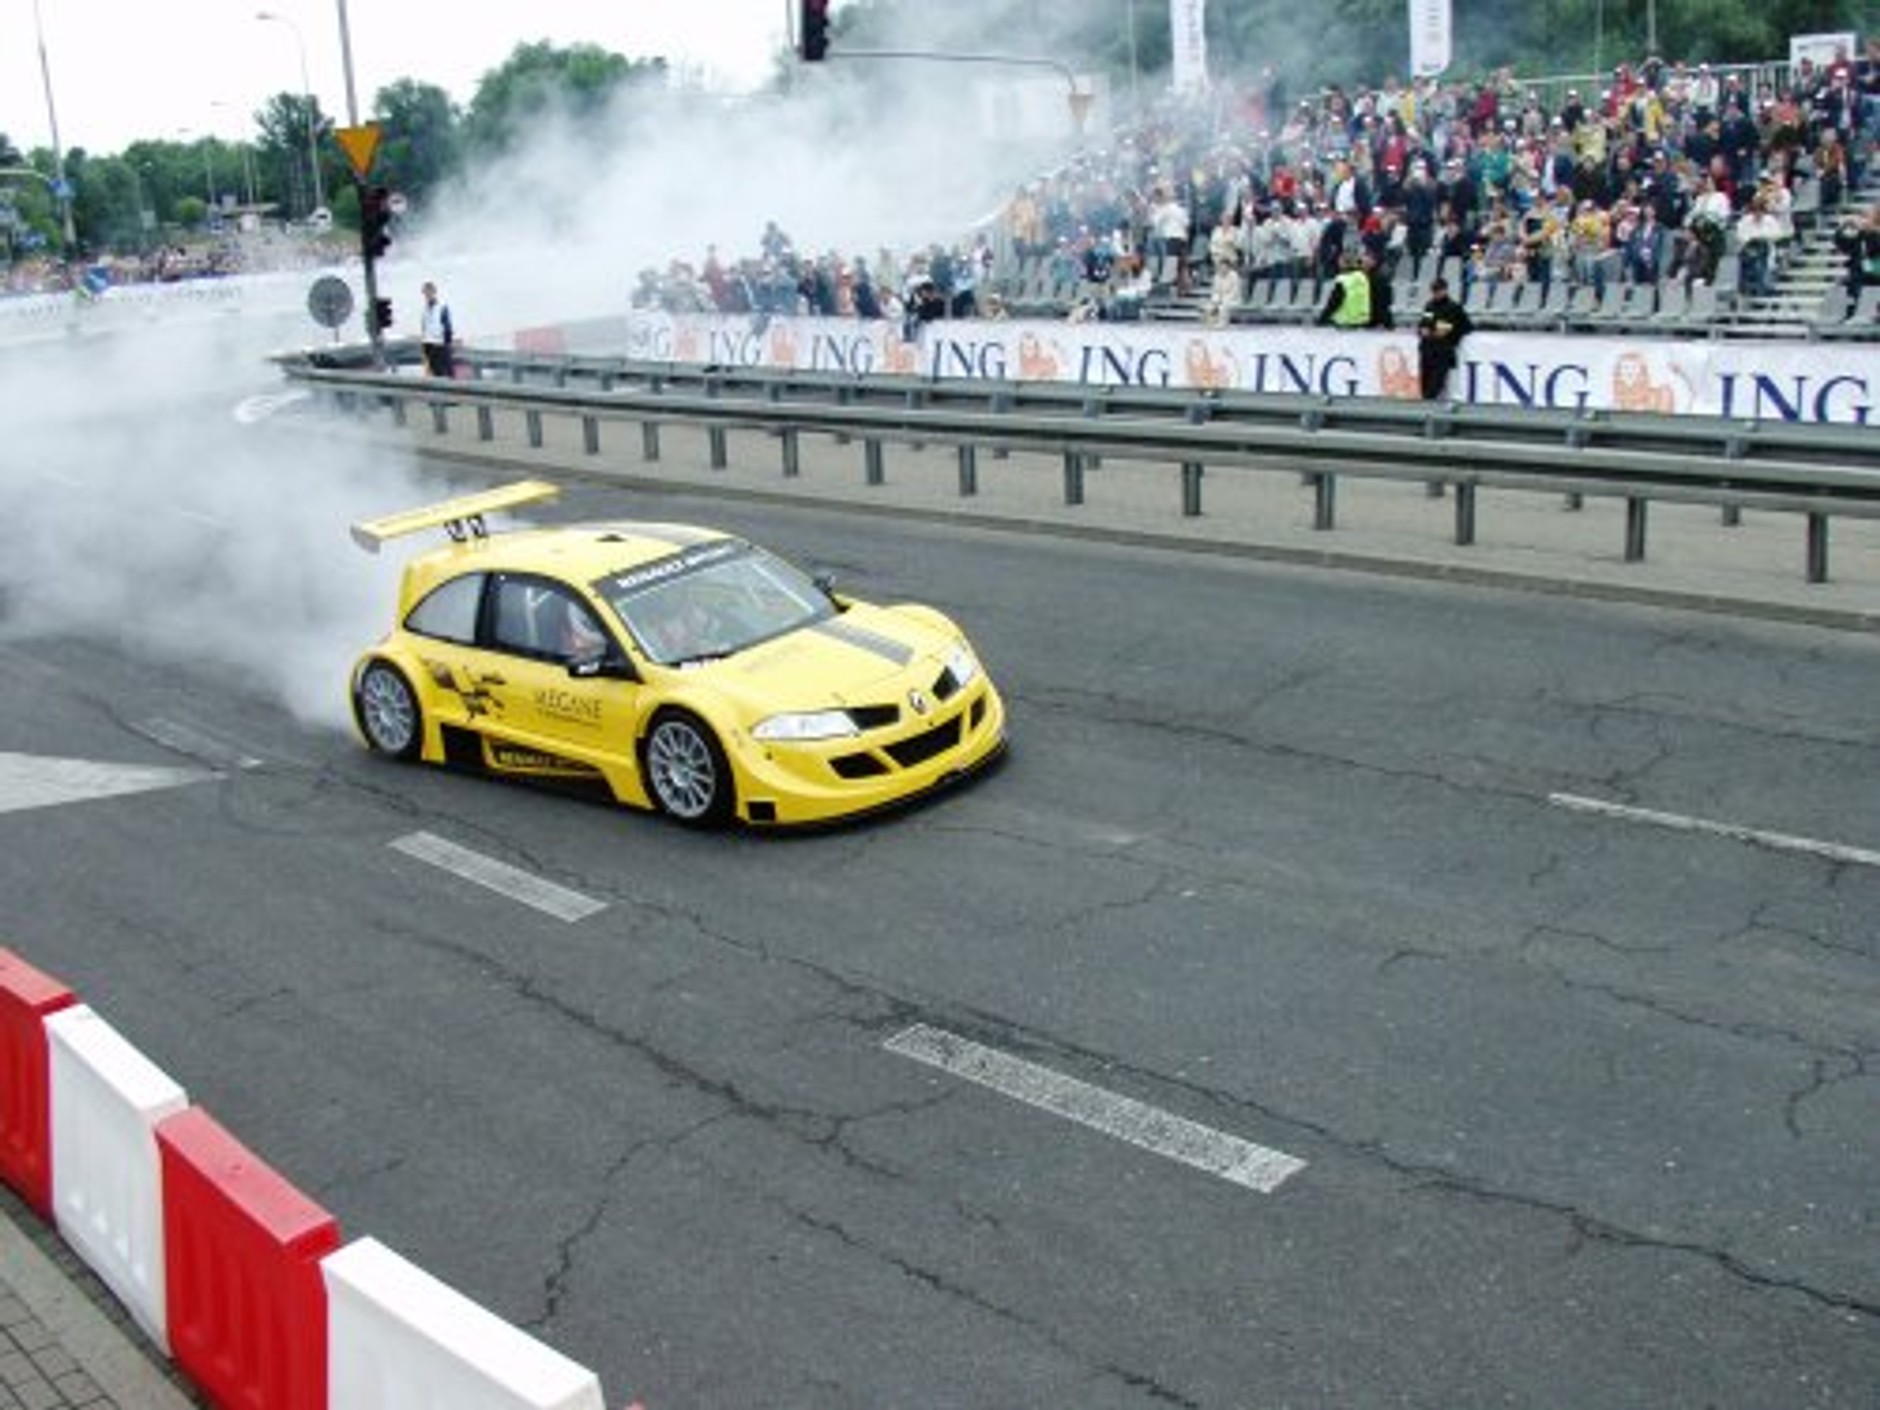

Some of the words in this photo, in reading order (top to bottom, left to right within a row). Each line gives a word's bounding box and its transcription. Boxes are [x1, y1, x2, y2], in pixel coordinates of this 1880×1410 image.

[811, 334, 873, 374] ING
[932, 339, 1005, 383] ING
[1079, 345, 1170, 388] ING
[1253, 352, 1360, 397] ING
[1464, 360, 1590, 410] ING
[1715, 372, 1873, 424] ING
